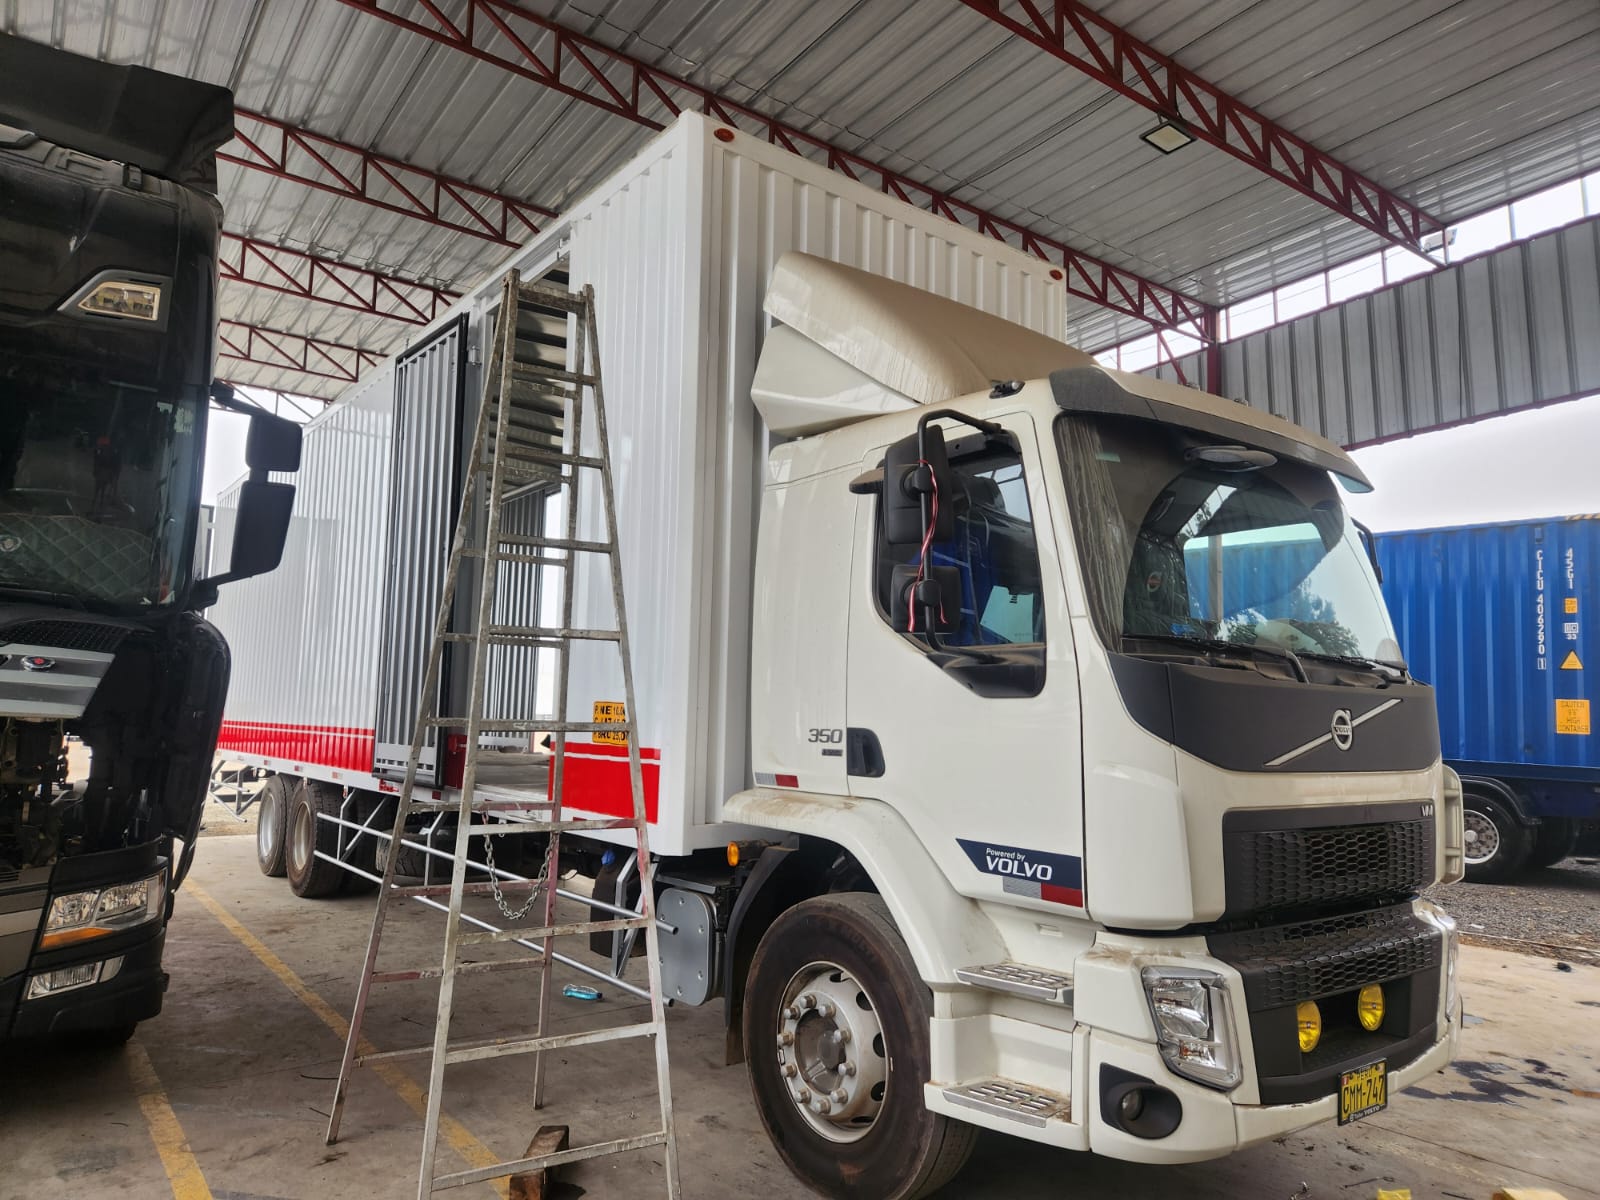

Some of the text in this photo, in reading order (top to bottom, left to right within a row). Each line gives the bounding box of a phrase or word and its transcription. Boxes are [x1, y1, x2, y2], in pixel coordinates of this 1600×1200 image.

[1565, 548, 1574, 589] 45G1
[1536, 593, 1545, 655] 406290
[808, 728, 843, 743] 350
[986, 848, 1026, 861] Powered by
[986, 855, 1053, 880] VOLVO
[1357, 1068, 1372, 1080] PERU
[1343, 1075, 1384, 1114] CMM-747
